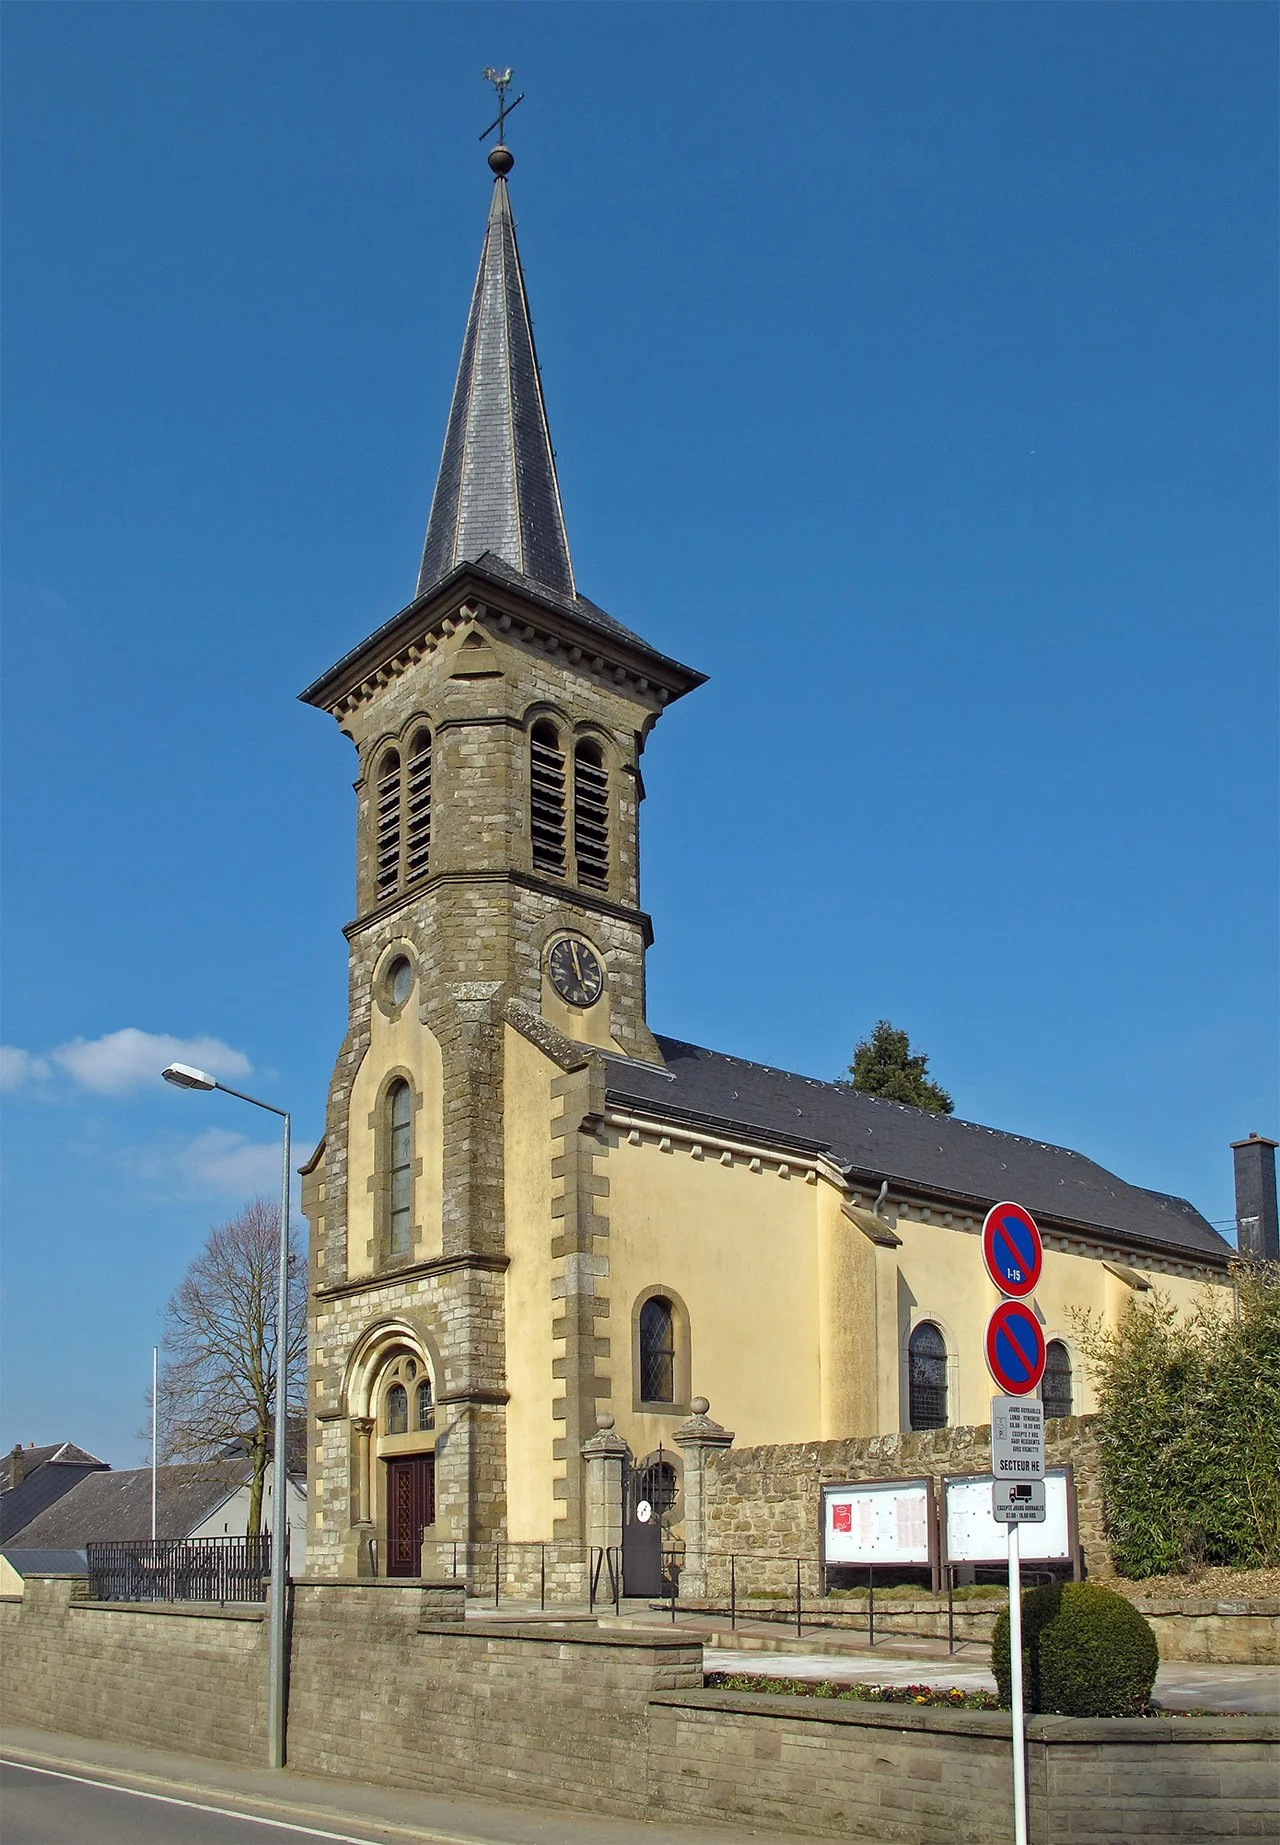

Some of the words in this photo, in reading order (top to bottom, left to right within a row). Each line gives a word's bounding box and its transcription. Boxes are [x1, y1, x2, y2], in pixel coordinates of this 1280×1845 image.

[1007, 1268, 1021, 1281] 1-15
[1000, 1460, 1030, 1471] SECTEUR
[1031, 1461, 1039, 1471] HE
